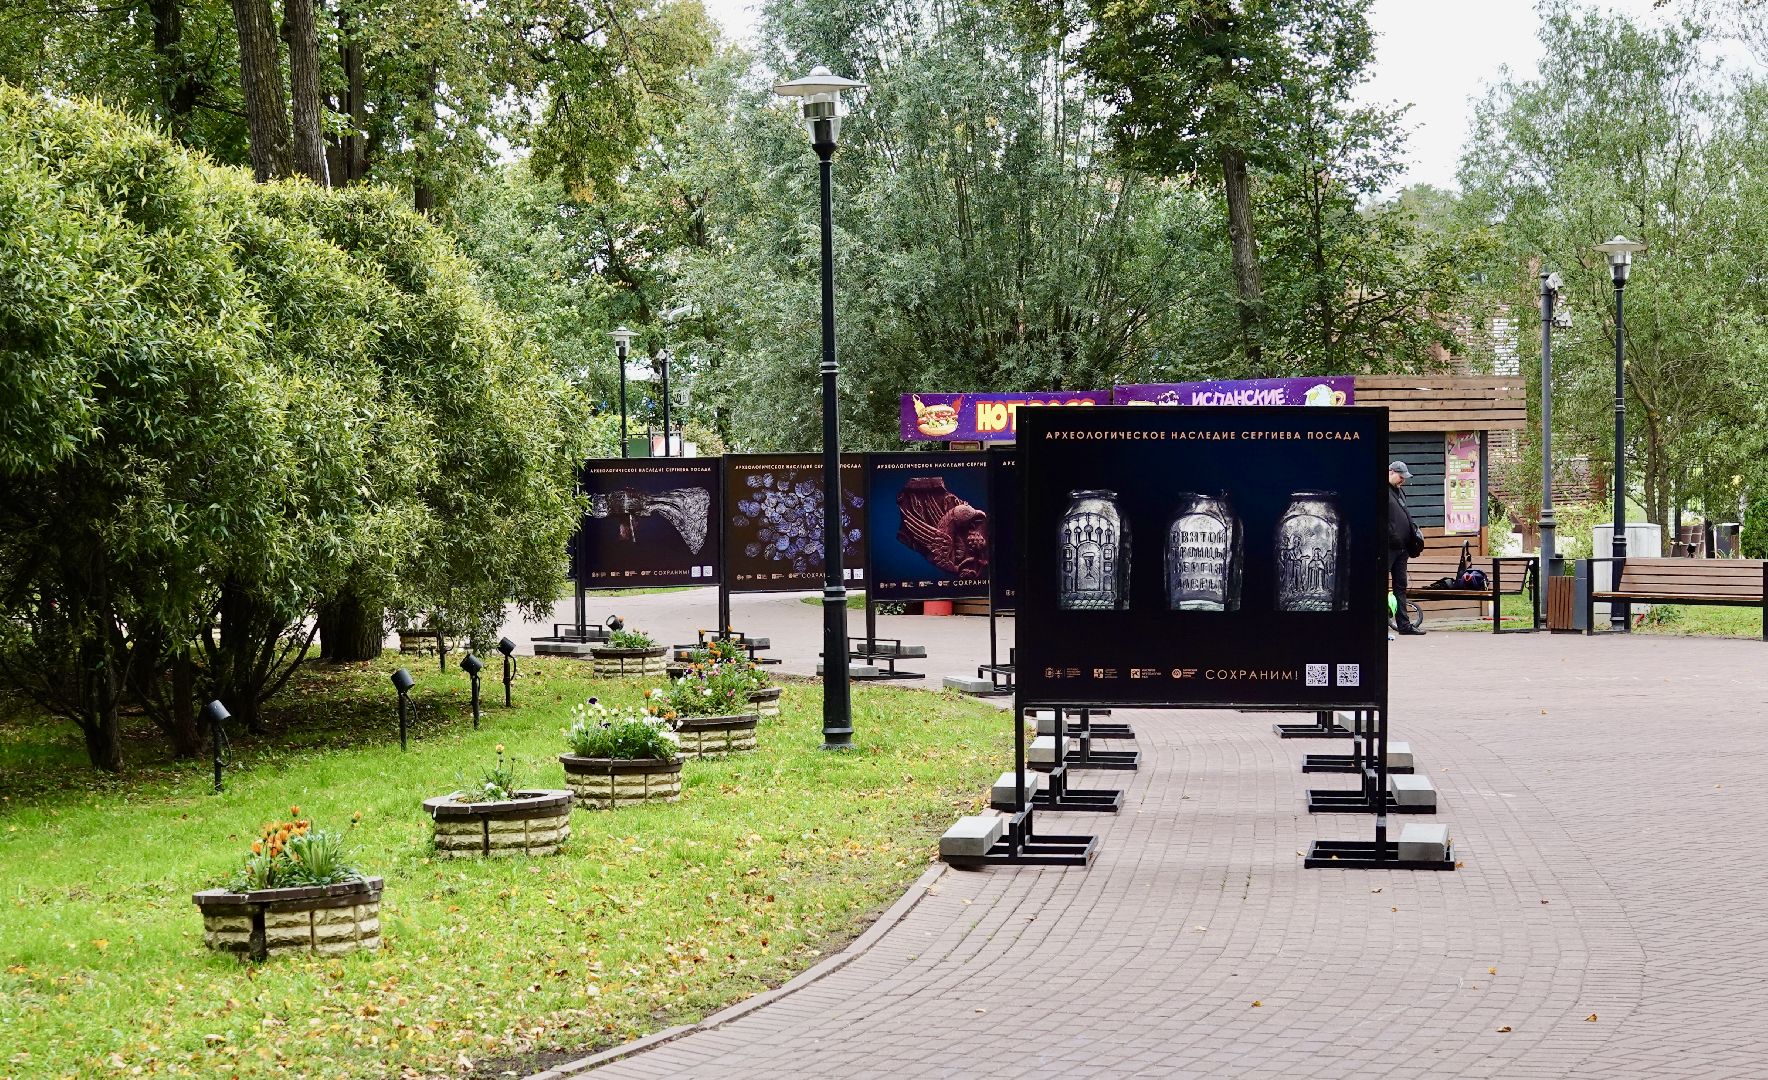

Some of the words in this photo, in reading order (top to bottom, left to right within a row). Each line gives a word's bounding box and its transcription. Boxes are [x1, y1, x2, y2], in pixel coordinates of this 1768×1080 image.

[1191, 387, 1286, 406] ИСПАНСКИЕ
[1045, 431, 1166, 441] АРХЕОЛОГИЧЕСКОЕ
[1171, 431, 1236, 441] НАСЛЕДИЕ
[1241, 431, 1301, 441] СЕРГИЕВА
[1307, 431, 1360, 441] ПОСАДА
[952, 579, 990, 587] СОХРАНИ
[1205, 669, 1299, 680] СОХРАНИМ!
